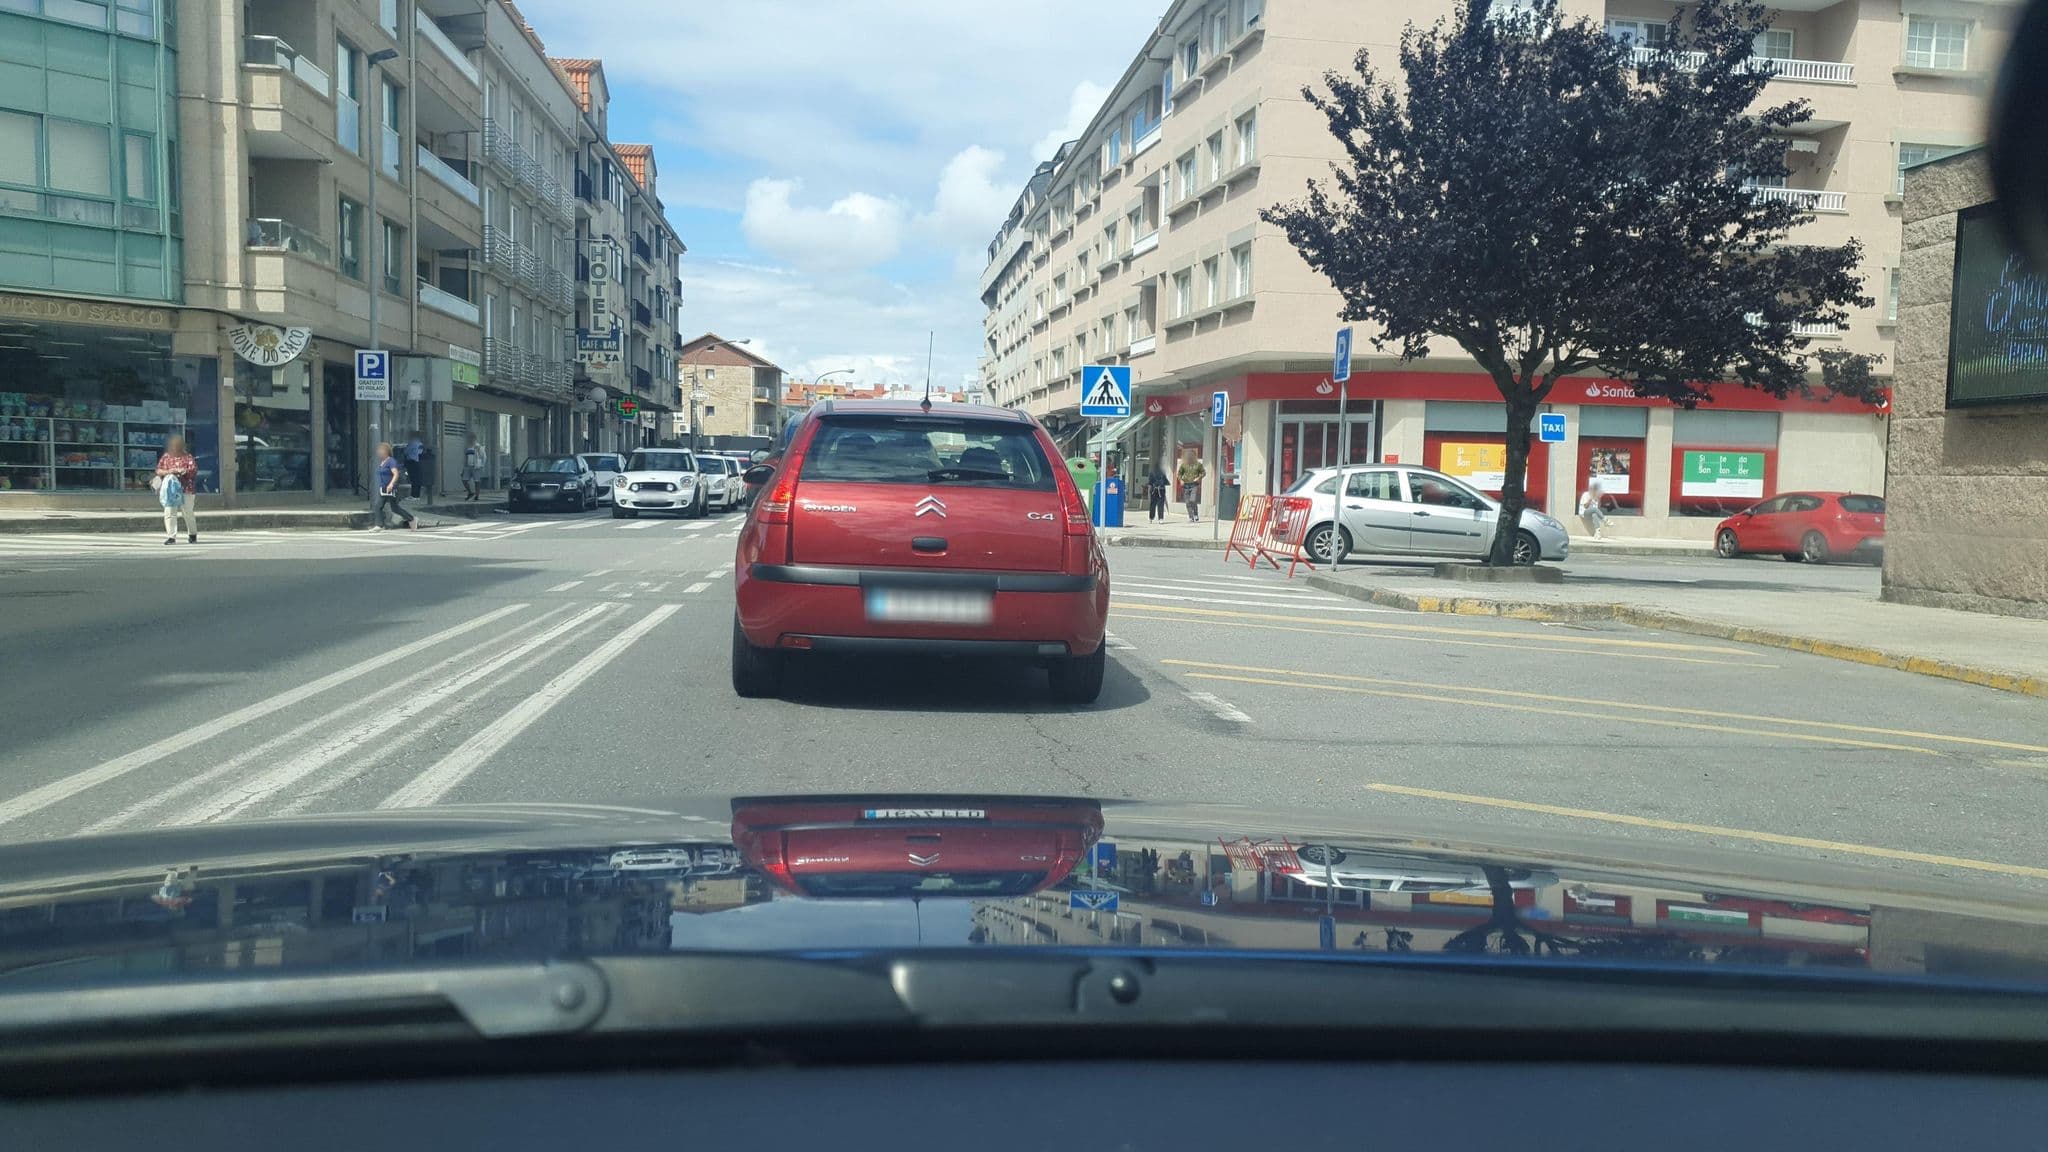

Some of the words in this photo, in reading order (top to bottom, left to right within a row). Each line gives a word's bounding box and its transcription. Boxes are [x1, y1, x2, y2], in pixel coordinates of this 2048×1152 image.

[590, 245, 607, 332] HOTEL
[229, 327, 260, 361] HOME
[263, 349, 279, 363] DO
[279, 329, 305, 359] SACO
[1336, 336, 1346, 375] P
[362, 354, 380, 377] P
[1214, 397, 1222, 422] P
[1542, 423, 1564, 433] TAXI
[1026, 511, 1056, 521] C4
